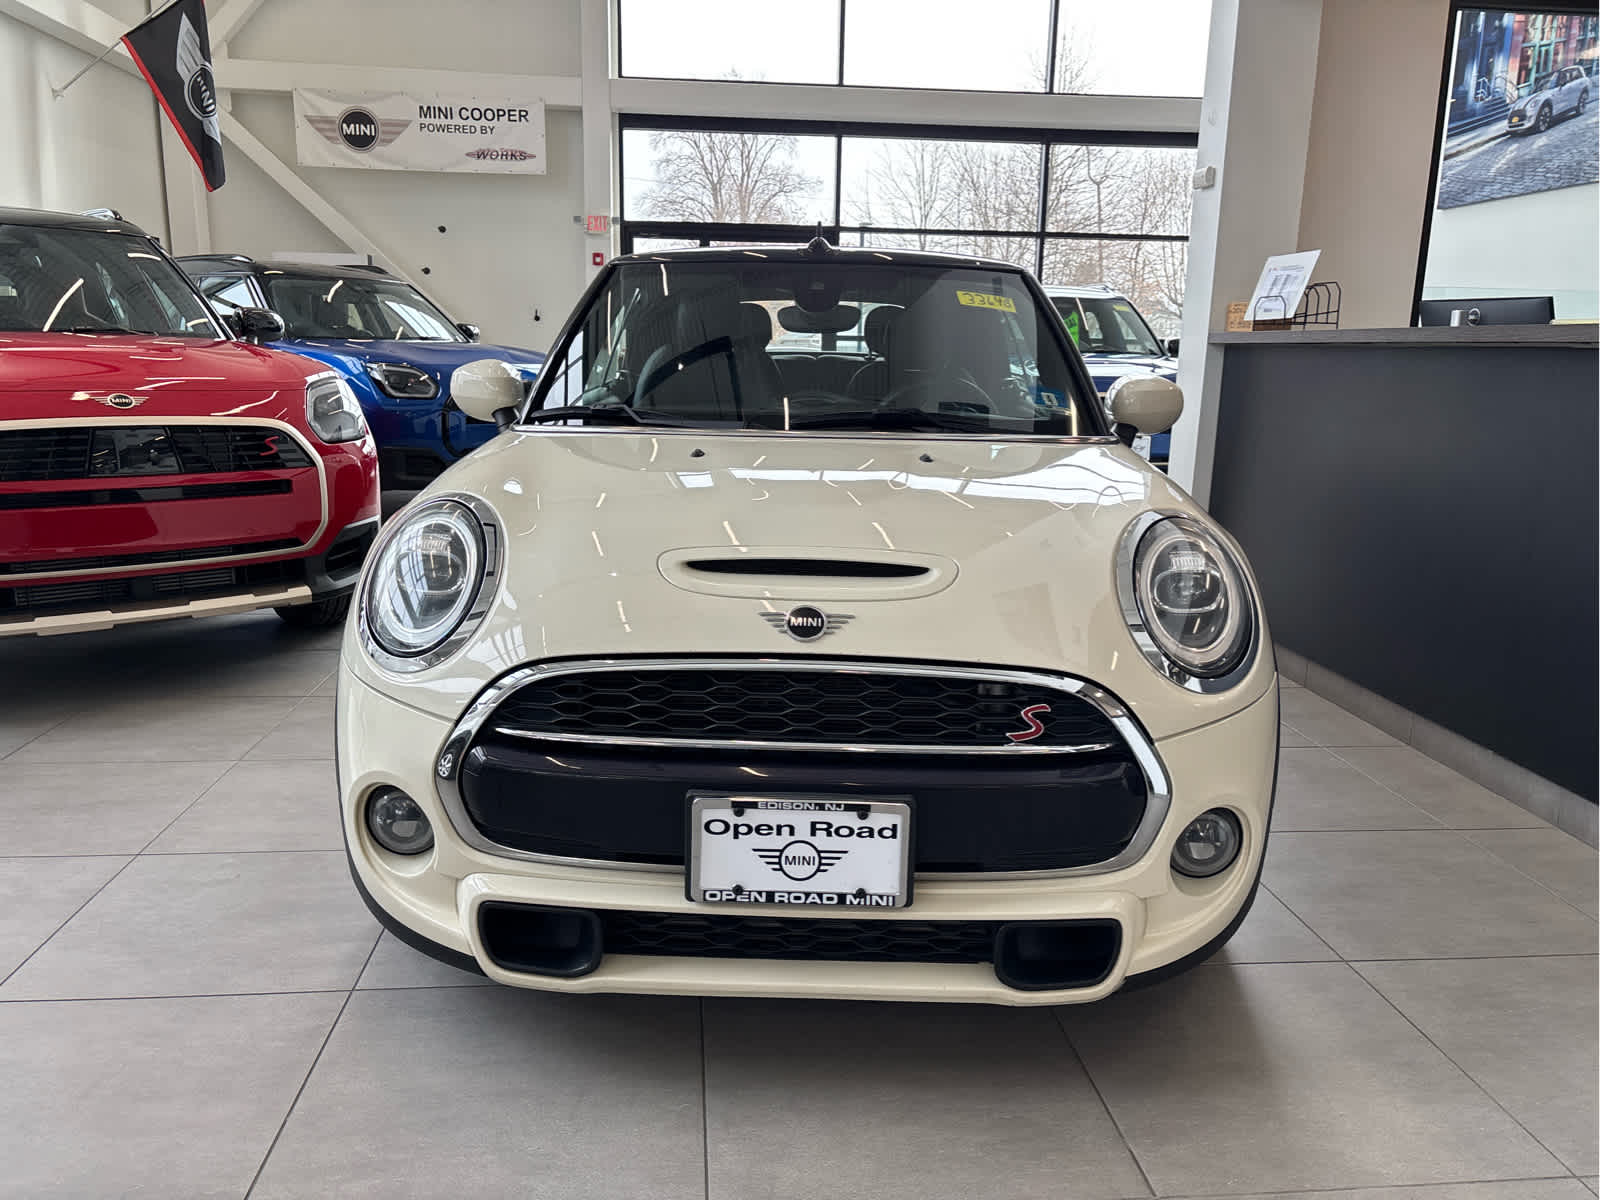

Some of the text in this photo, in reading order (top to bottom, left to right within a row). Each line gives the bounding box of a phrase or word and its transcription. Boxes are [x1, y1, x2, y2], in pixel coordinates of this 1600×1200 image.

[418, 105, 529, 123] MINI COOPER
[341, 121, 376, 137] MINI
[419, 122, 496, 136] POWERED BY
[476, 150, 528, 161] WORKS
[587, 215, 608, 232] EXIT
[259, 435, 280, 456] S
[789, 616, 822, 627] MINI
[1005, 703, 1051, 742] S
[757, 801, 845, 811] EDISON, NJ
[703, 818, 898, 840] Open Road
[784, 855, 816, 867] MINI
[774, 892, 838, 905] ROAD
[846, 894, 894, 907] MINI
